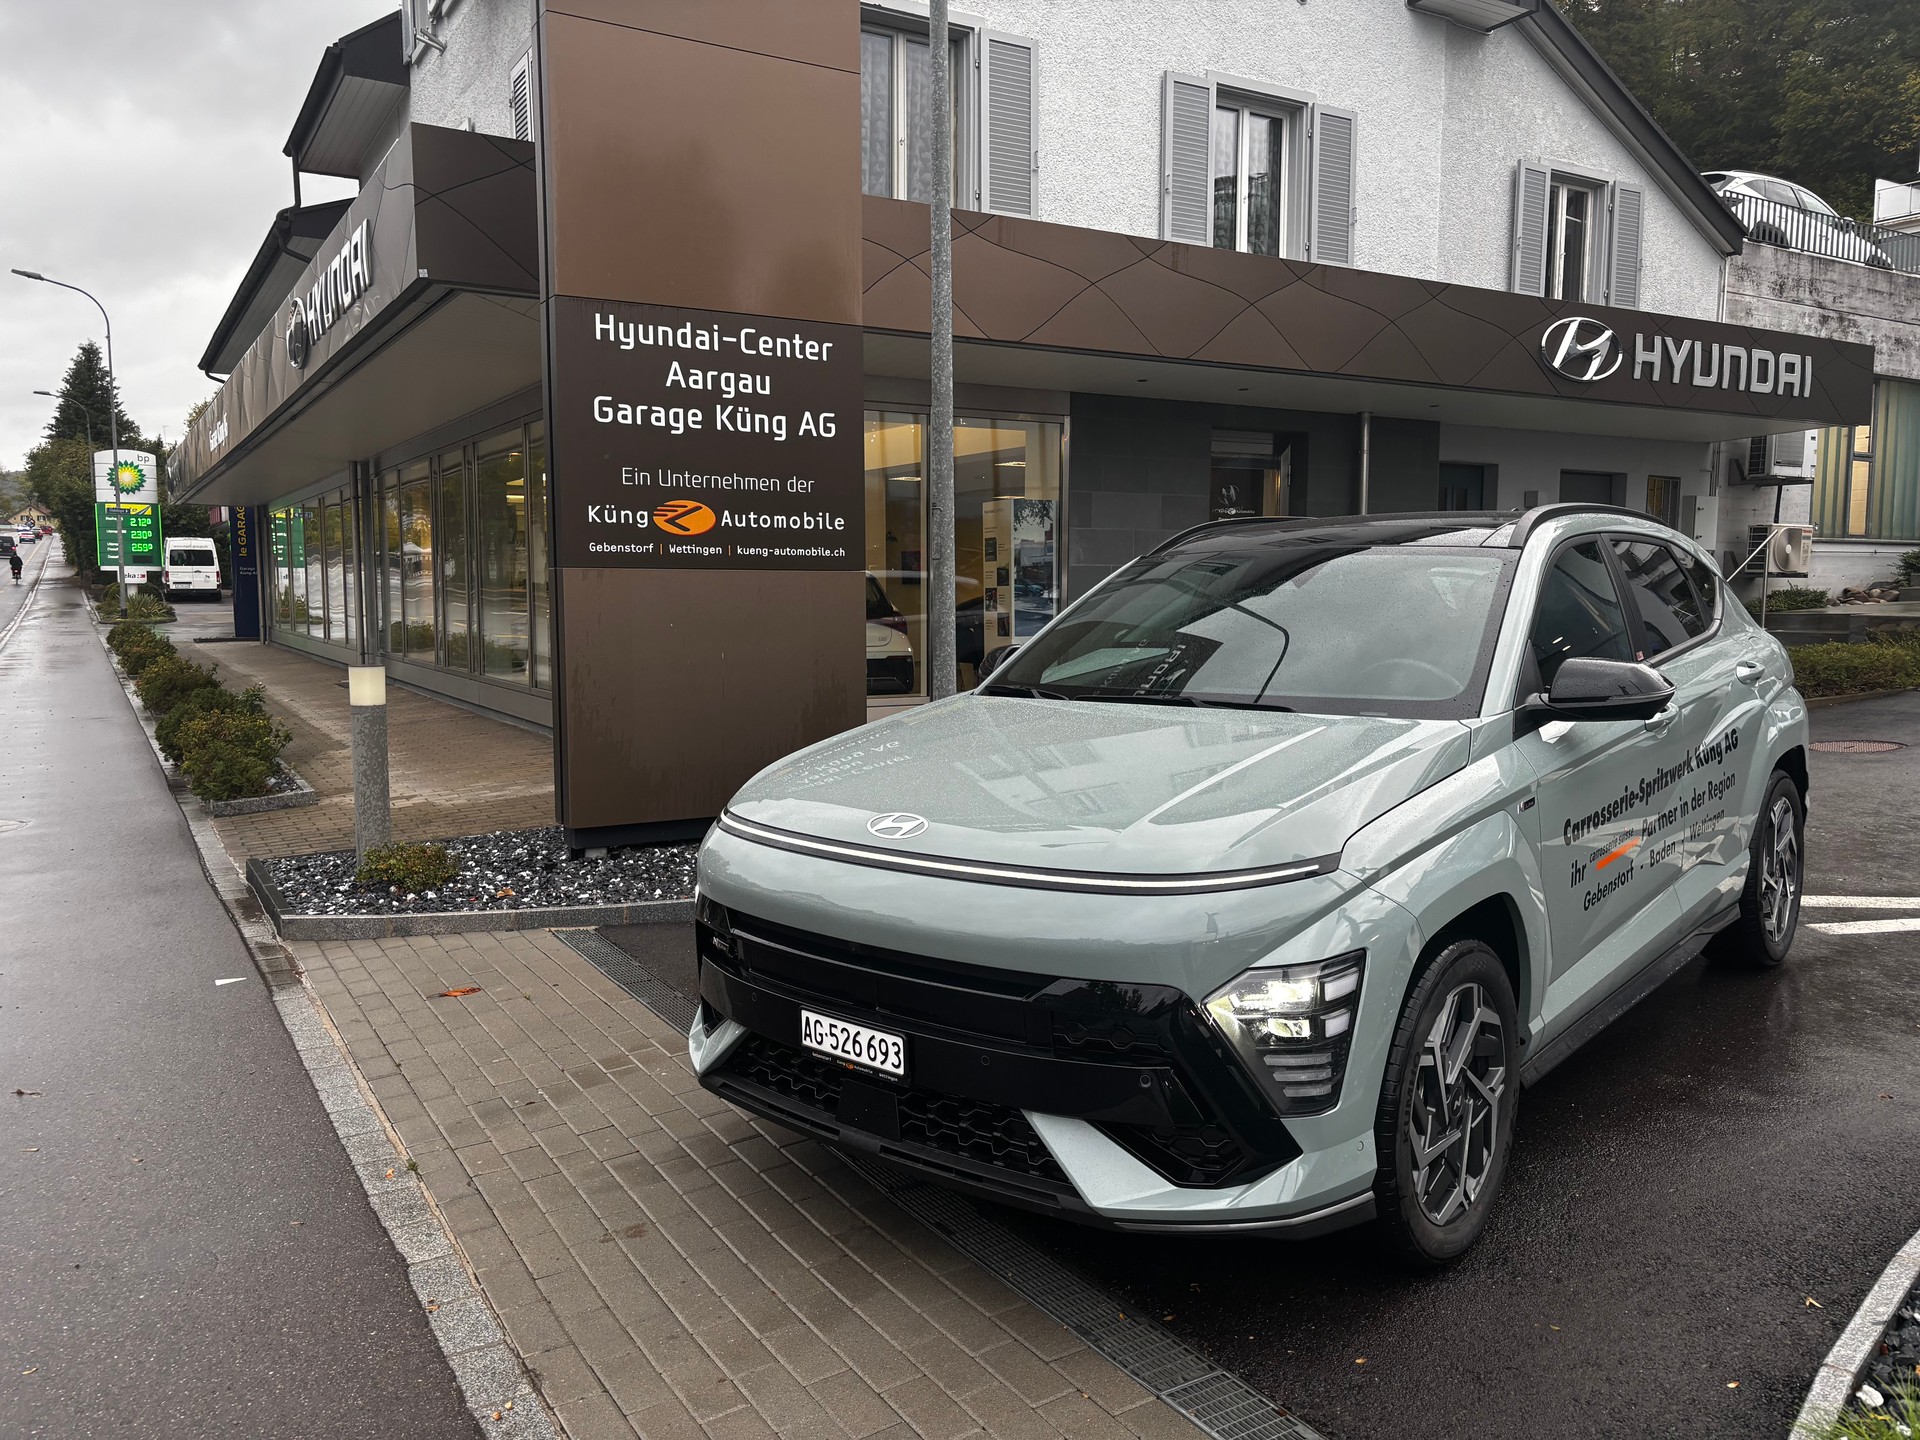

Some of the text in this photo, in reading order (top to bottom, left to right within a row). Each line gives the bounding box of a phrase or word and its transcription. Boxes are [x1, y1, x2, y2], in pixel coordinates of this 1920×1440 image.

[307, 218, 372, 346] HYUNDAI
[594, 313, 833, 361] Hyundai-Center
[665, 361, 771, 398] Aargau
[1633, 333, 1812, 398] HYUNDAI
[593, 395, 836, 441] Garage Küng AG
[137, 454, 150, 463] bp
[622, 467, 814, 493] Ein Unternehmen der
[588, 505, 845, 530] Küng Automobile
[589, 542, 846, 558] Gebenstorf Wettingen kueng-automobile.ch
[1563, 749, 1694, 846] Carrosserie-Spritzwerk
[1724, 728, 1739, 755] AG
[1570, 772, 1736, 888] ihr Partner in der Region
[1583, 860, 1634, 911] Gebenstorf
[1650, 840, 1676, 868] Baden
[1689, 809, 1725, 842] Wettingen
